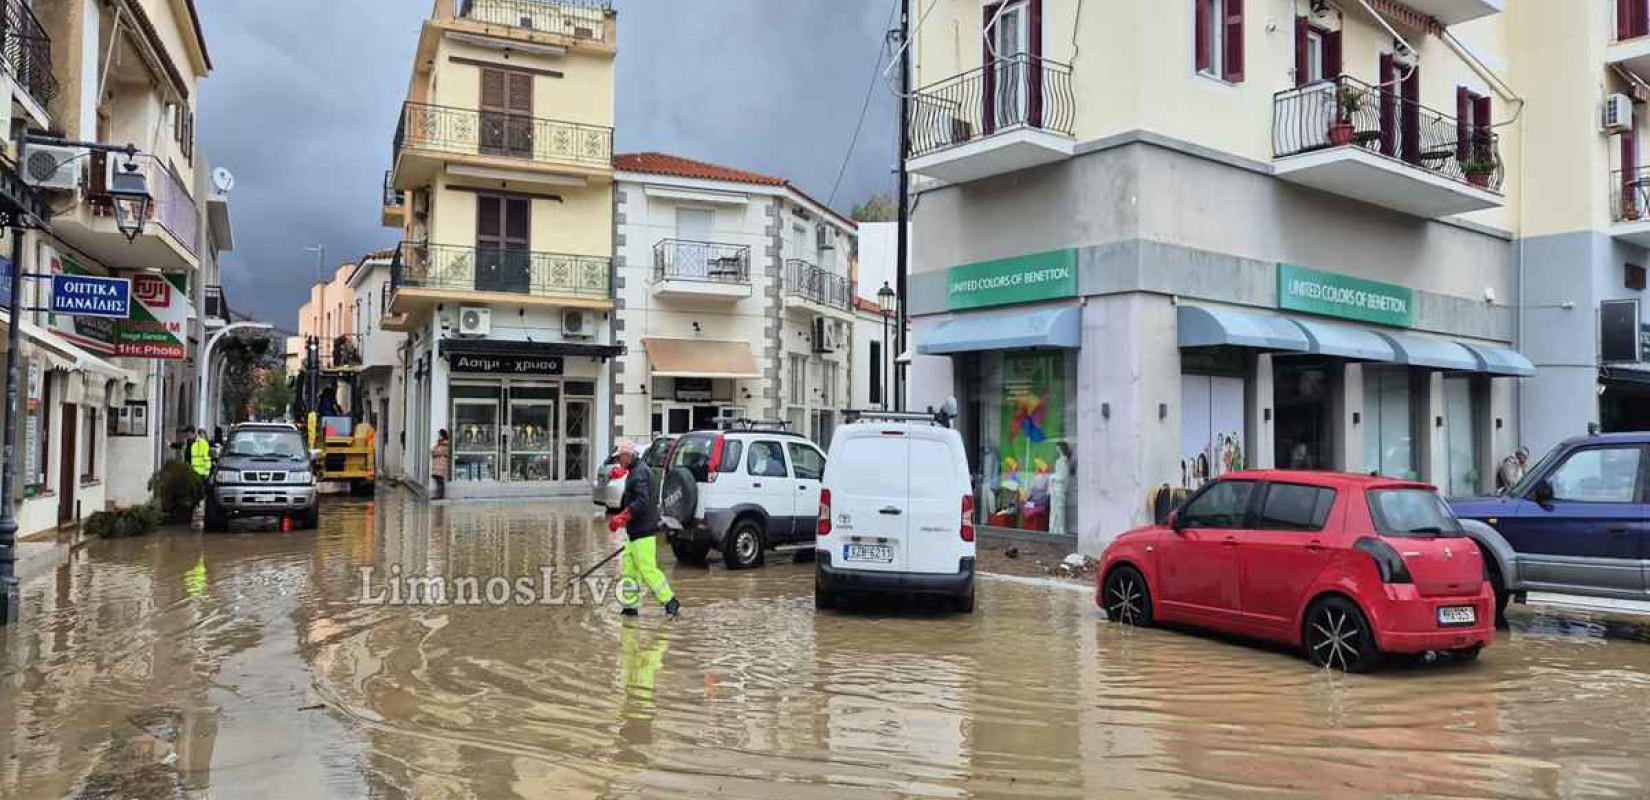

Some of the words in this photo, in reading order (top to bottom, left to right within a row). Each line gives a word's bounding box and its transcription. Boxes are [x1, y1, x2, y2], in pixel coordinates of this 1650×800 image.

[64, 281, 118, 296] ΟΠΤΙΚΑ
[978, 275, 1010, 290] COLORS
[1010, 273, 1023, 286] OF
[1289, 278, 1320, 298] UNITED
[1322, 284, 1354, 306] COLORS
[1355, 292, 1367, 307] OF
[143, 344, 182, 356] Photo
